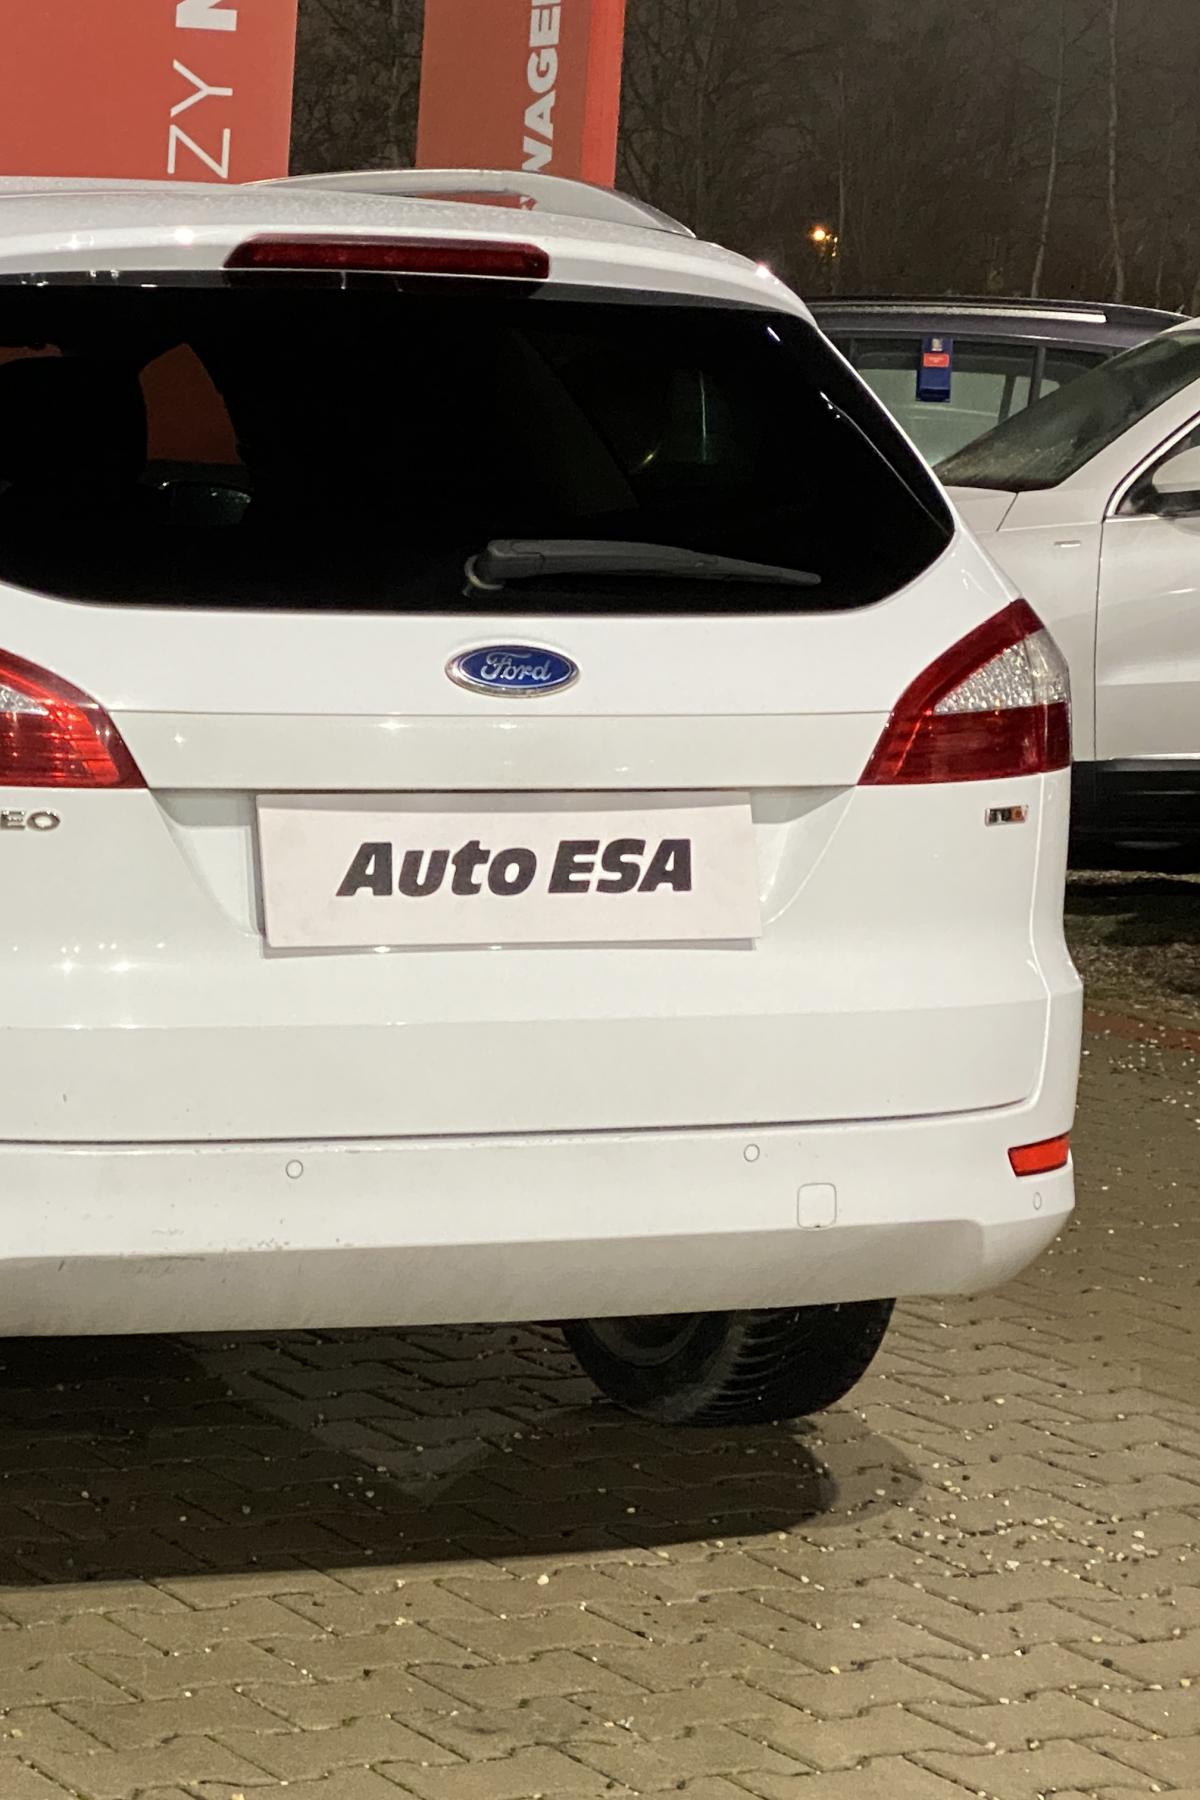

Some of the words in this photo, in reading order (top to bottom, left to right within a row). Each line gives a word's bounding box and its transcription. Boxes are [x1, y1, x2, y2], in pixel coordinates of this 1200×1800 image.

[520, 0, 561, 210] WAGE
[480, 651, 552, 681] Ford
[335, 840, 537, 897] Auto
[547, 838, 692, 893] ESA
